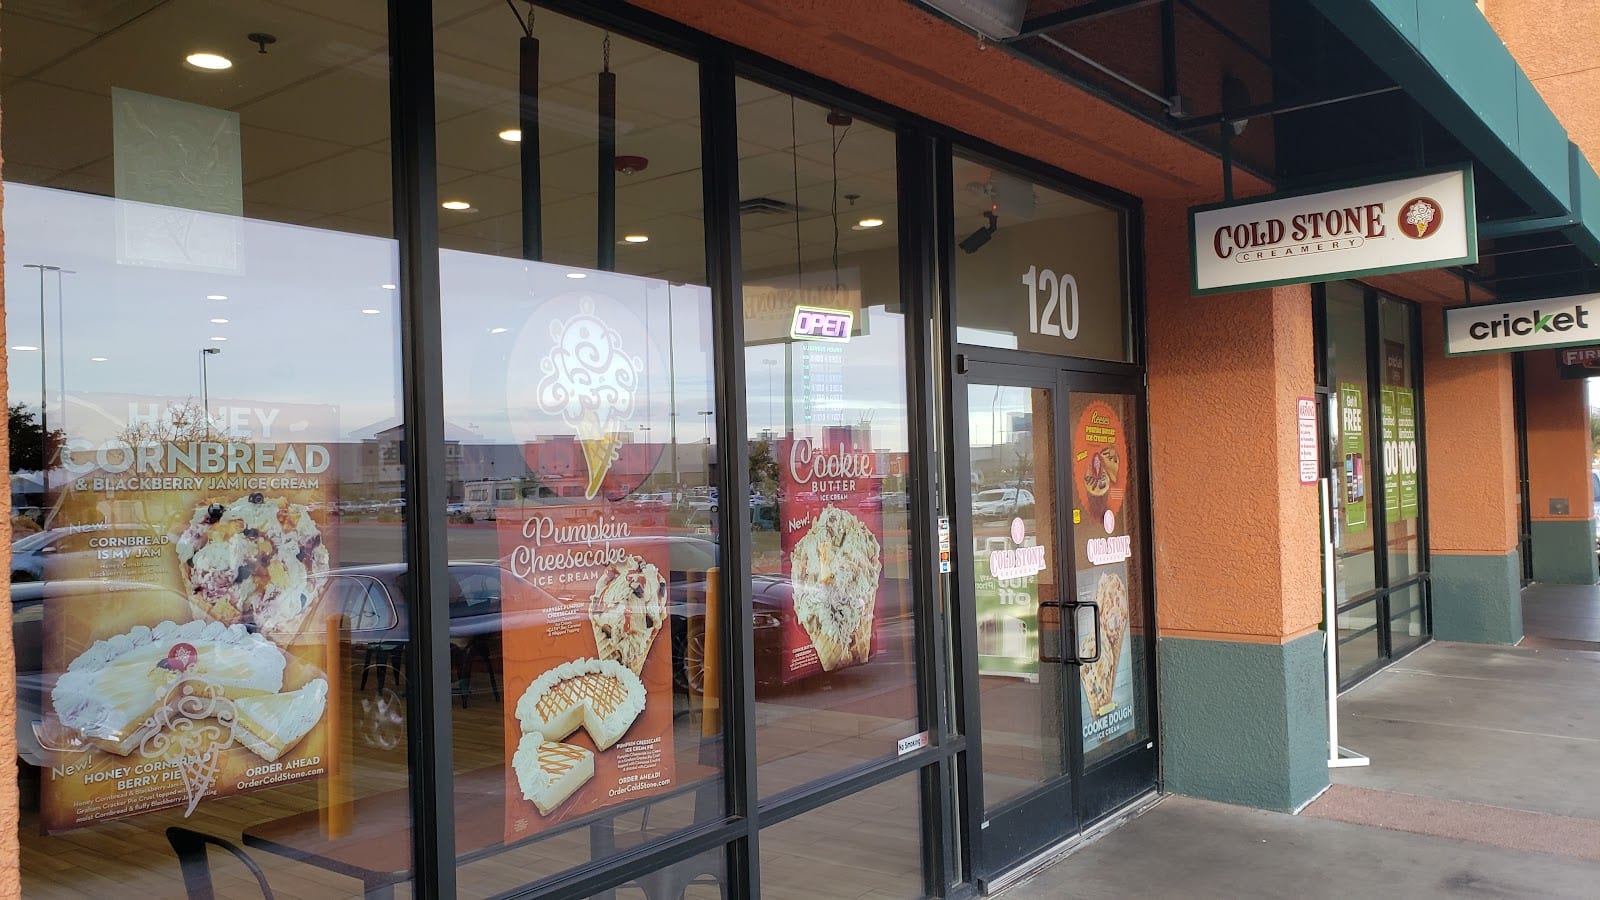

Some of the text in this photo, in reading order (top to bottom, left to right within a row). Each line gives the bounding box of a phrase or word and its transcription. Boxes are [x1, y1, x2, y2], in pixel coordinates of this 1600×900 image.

[1214, 202, 1386, 260] COLD STONE
[1242, 239, 1357, 261] CREAMERY
[1022, 264, 1080, 340] 120
[795, 311, 851, 339] OPEN
[1469, 304, 1589, 341] cricket
[128, 401, 280, 439] HONEY
[1343, 408, 1362, 432] FREE
[60, 439, 331, 474] CORNBREAD
[790, 436, 873, 484] Cookie
[1398, 440, 1417, 474] $100
[75, 476, 320, 491] & BLACKBERRY JAM ICE CREAM
[812, 480, 856, 492] BUTTER
[830, 493, 849, 501] CREAM
[69, 515, 108, 535] New!
[522, 515, 631, 548] Pumpkin
[788, 511, 811, 533] New!
[89, 534, 170, 548] CORNBREAD
[98, 548, 161, 560] IS MY JAM
[510, 542, 628, 579] Cheesecake
[534, 571, 600, 588] ICE CREAM
[1082, 703, 1133, 738] COOKIE DOUGH
[1096, 724, 1120, 740] ICE CREAM
[904, 738, 921, 750] Smoking
[52, 754, 92, 782] New!
[84, 766, 131, 785] HONEY
[246, 756, 320, 778] ORDER AHEAD
[618, 771, 661, 785] ORDER AHEAD!
[117, 774, 159, 791] BERRY
[162, 770, 182, 782] PIE
[236, 767, 324, 790] OrderColdStone.com
[608, 778, 671, 798] OrderColdStone.com
[76, 805, 102, 815] Graham
[102, 800, 126, 810] Cracker
[138, 793, 155, 802] Crust
[95, 791, 128, 803] Cornbread
[94, 807, 128, 819] Cornbread
